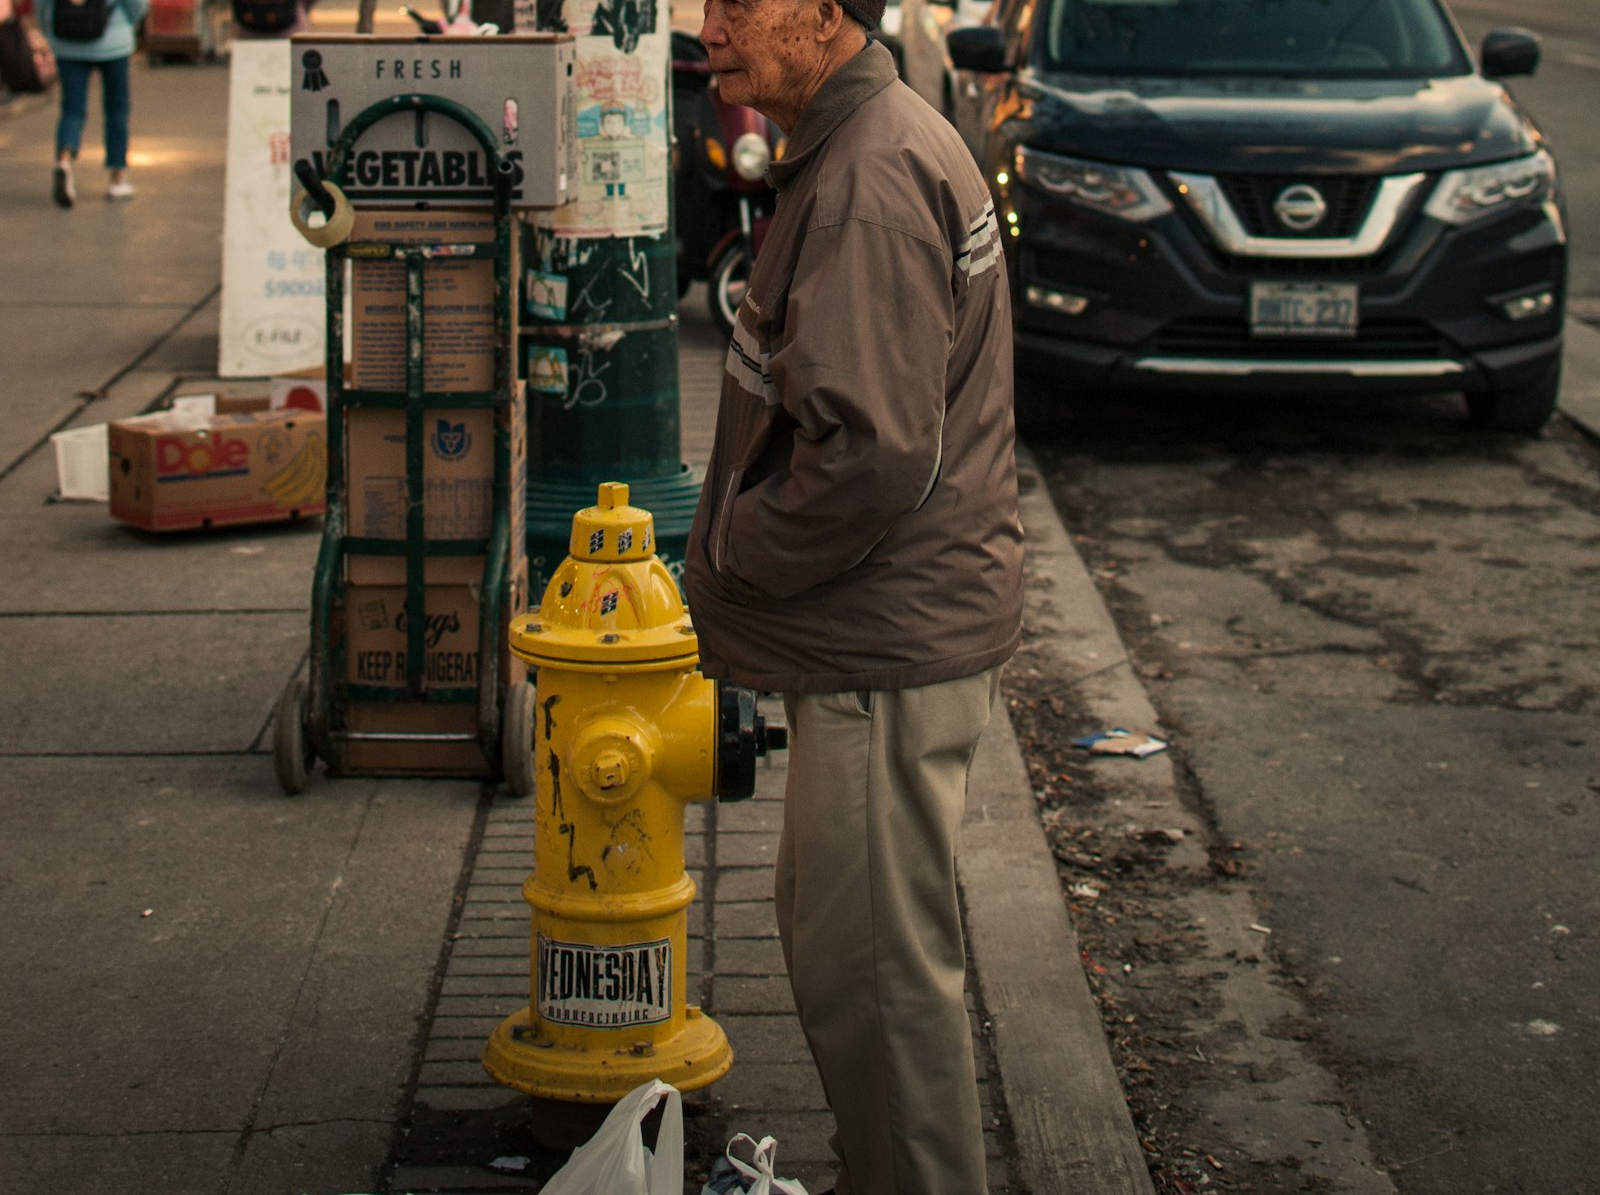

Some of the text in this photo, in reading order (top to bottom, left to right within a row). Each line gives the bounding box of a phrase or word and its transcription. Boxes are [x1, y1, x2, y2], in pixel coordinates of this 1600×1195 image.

[376, 59, 462, 79] FRESH
[156, 431, 250, 474] Dole
[357, 652, 391, 681] KEEP
